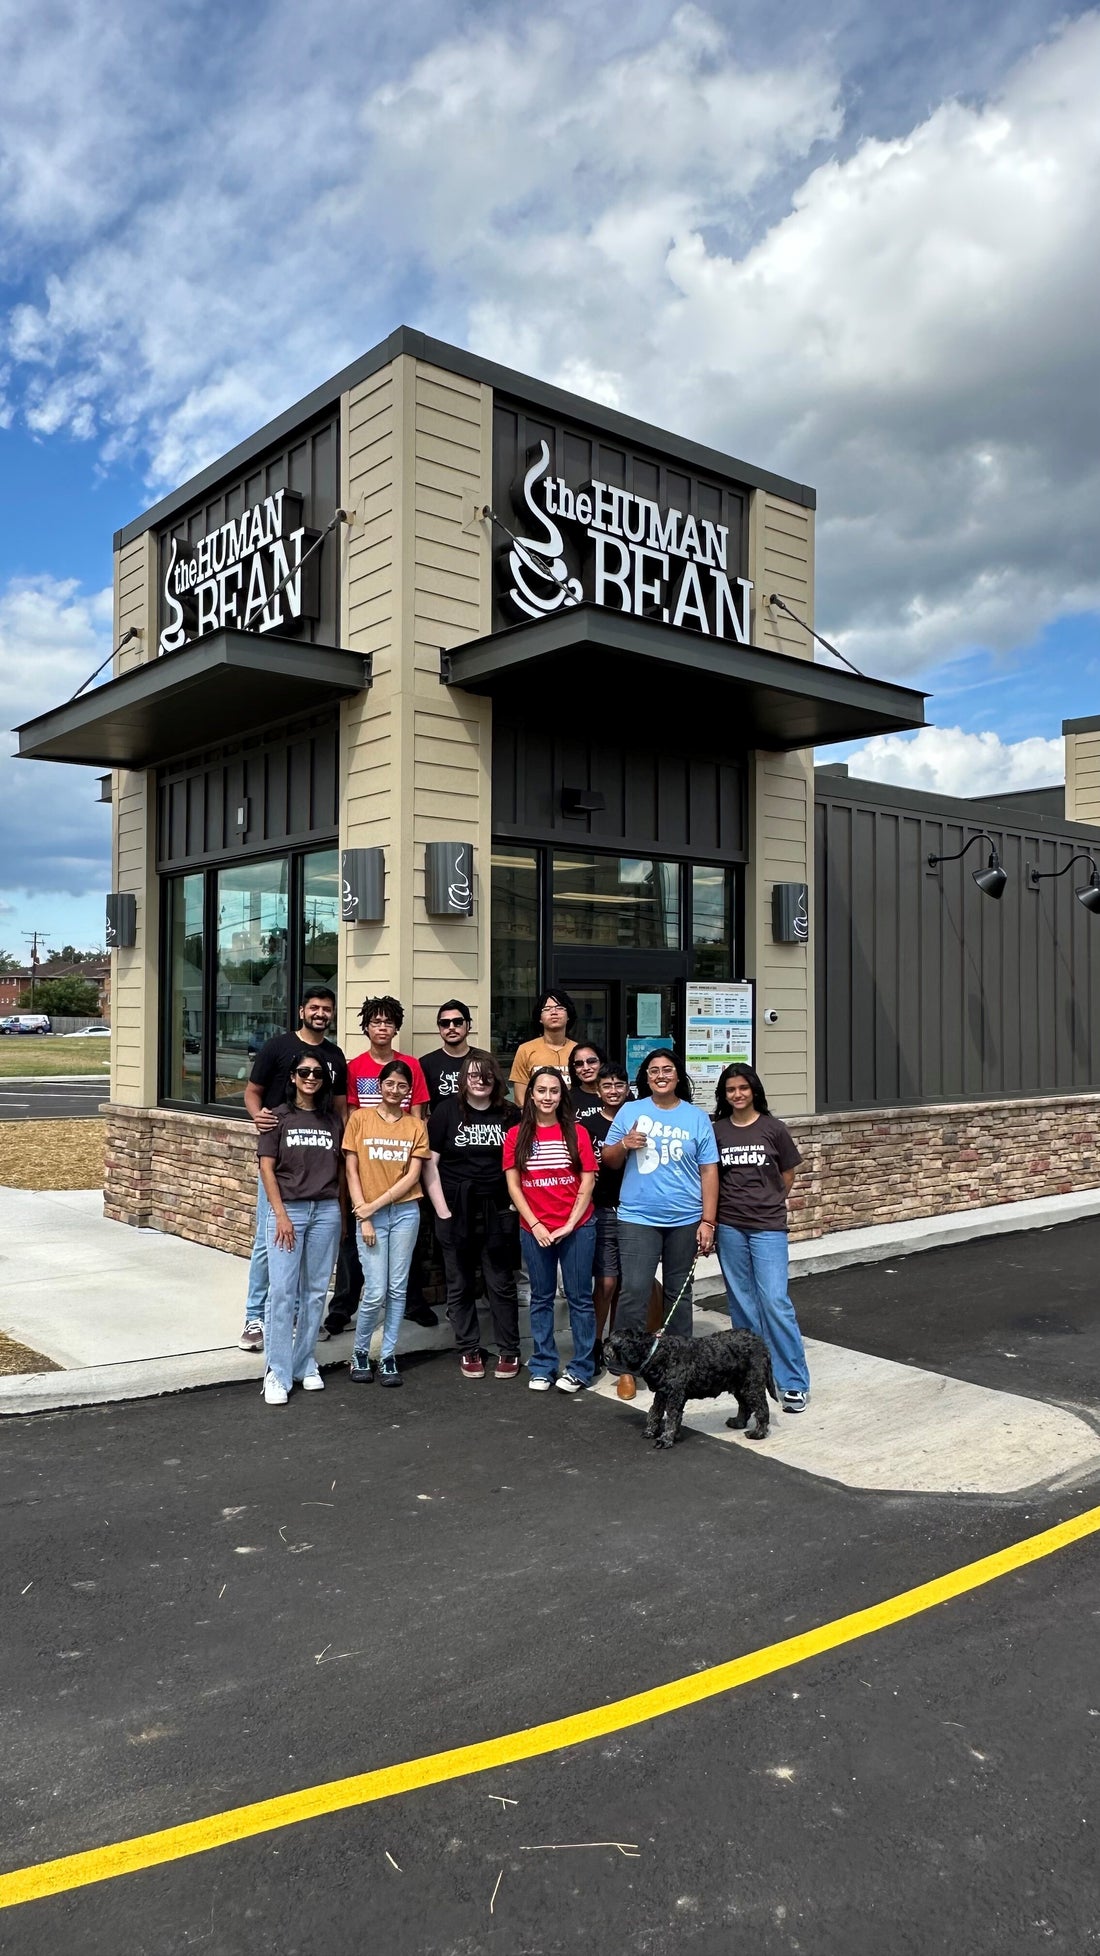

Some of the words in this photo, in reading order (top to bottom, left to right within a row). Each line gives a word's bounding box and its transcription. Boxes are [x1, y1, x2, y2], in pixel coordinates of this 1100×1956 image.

[544, 476, 593, 525] the
[591, 479, 729, 570] HUMAN
[174, 556, 197, 595] the
[196, 488, 285, 584] HUMAN
[194, 527, 305, 636] BEAN
[587, 528, 754, 645] BEAN
[472, 1124, 502, 1133] HUMAN
[636, 1115, 689, 1140] DREAM
[286, 1135, 333, 1150] Muddy
[368, 1146, 408, 1162] Mexi
[720, 1151, 766, 1166] Muddy
[532, 1176, 559, 1187] HUMAN
